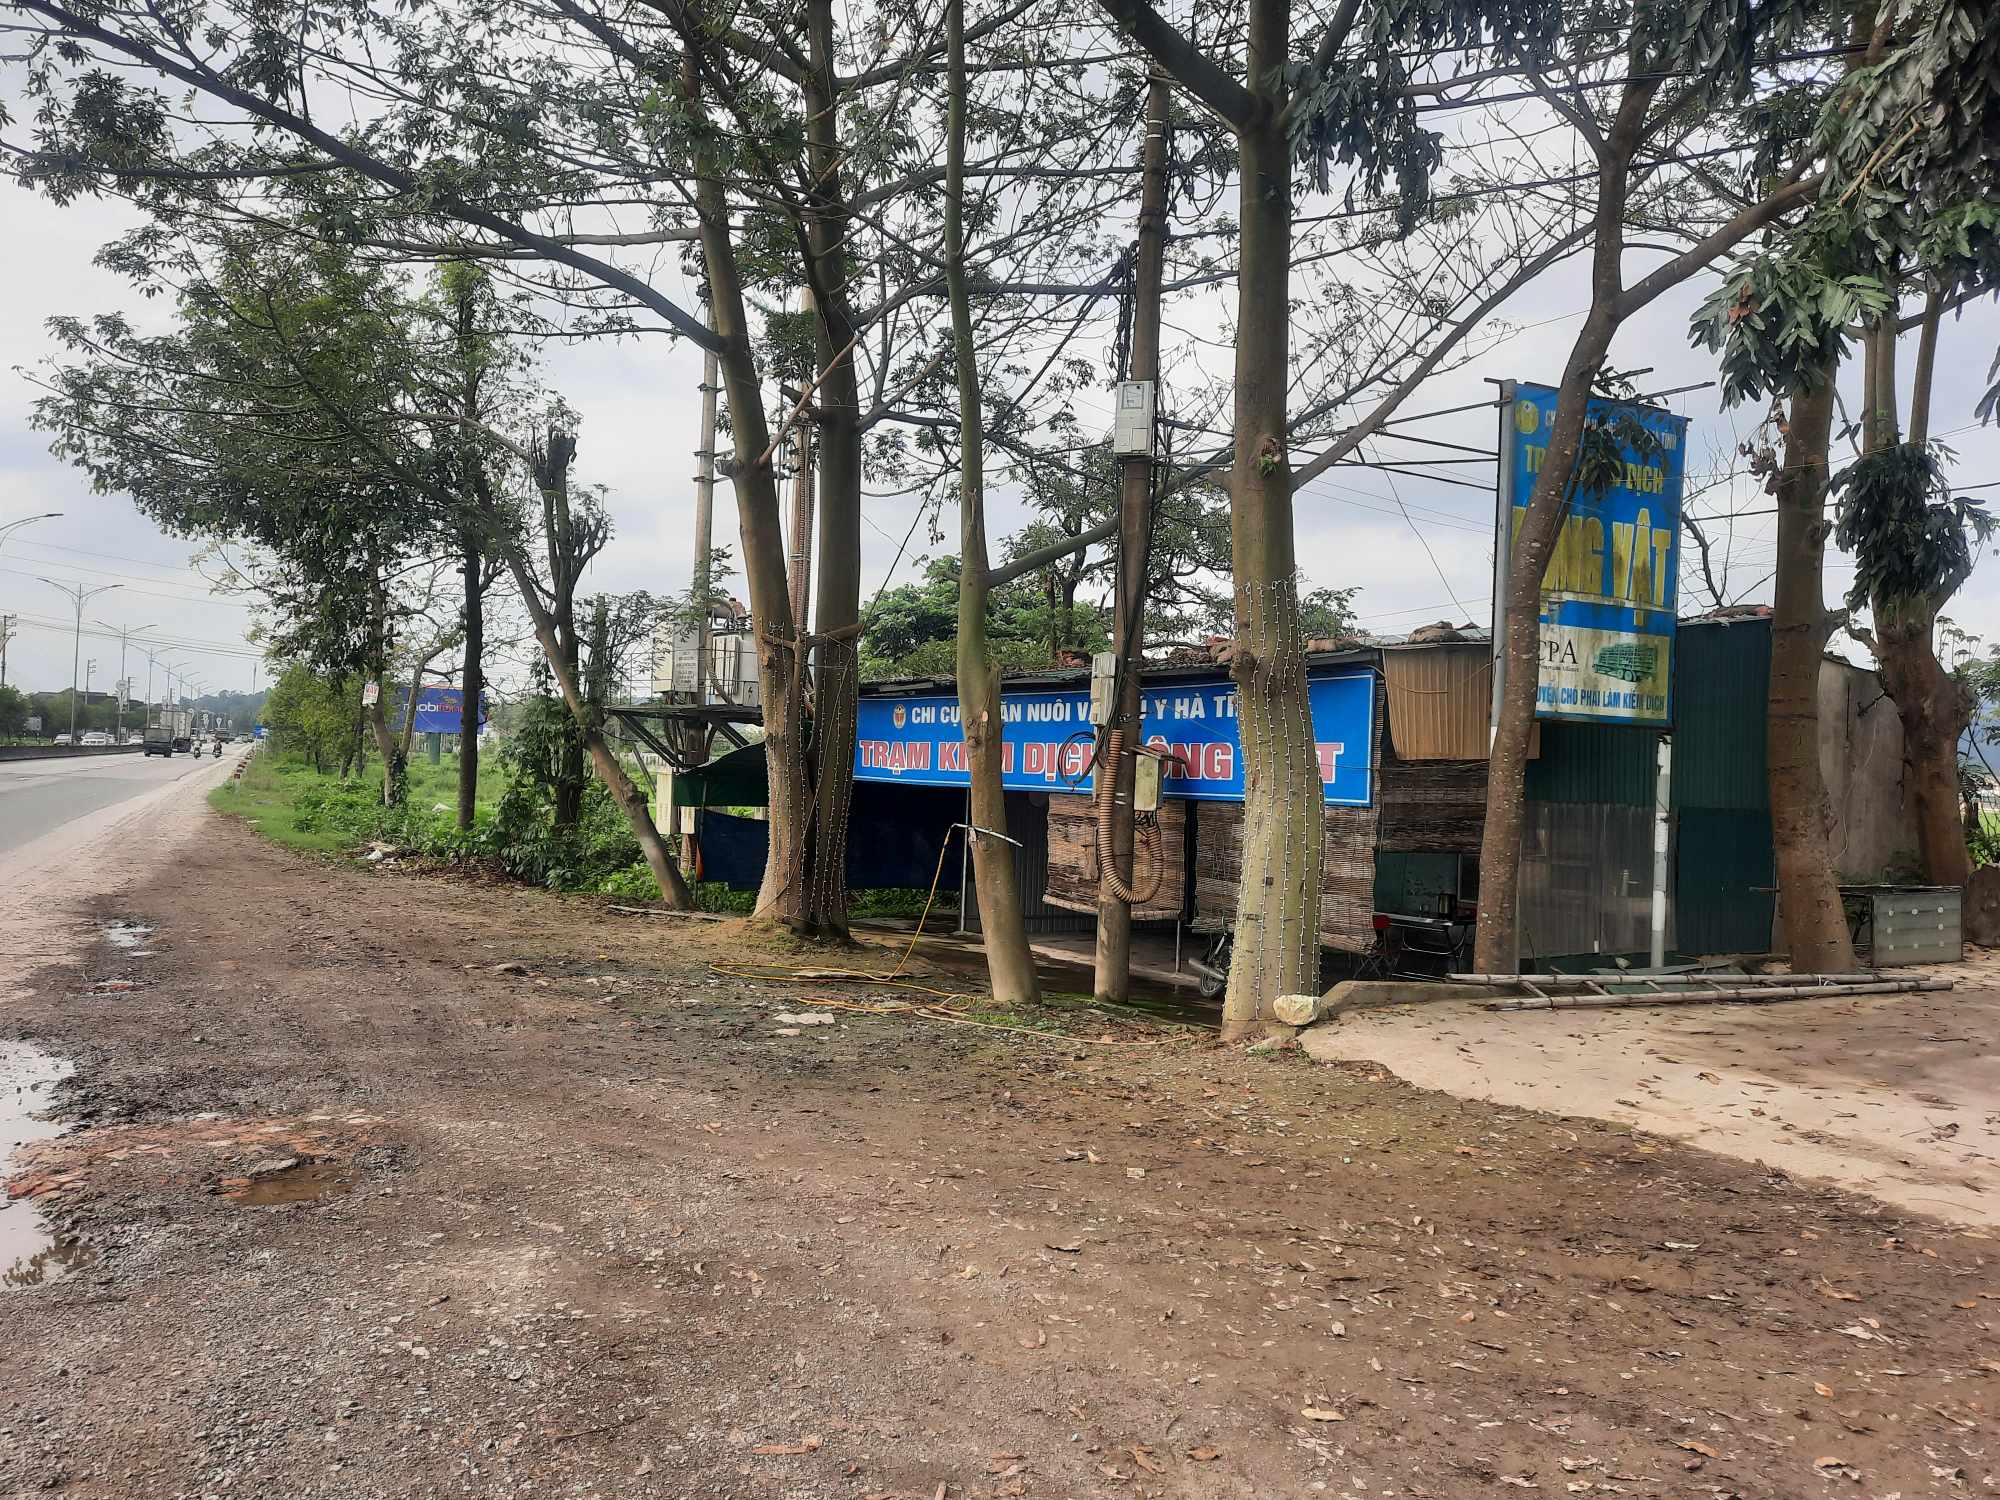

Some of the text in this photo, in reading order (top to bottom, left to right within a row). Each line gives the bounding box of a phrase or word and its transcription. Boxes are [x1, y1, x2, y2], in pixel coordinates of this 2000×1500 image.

[1612, 507, 1672, 626] VẬT
[911, 706, 936, 724] CHI
[940, 706, 961, 727] CỤ
[1027, 698, 1071, 722] NUÔI
[1151, 698, 1168, 720] Y
[1174, 692, 1205, 719] HÀ
[860, 740, 931, 775] TRẠM
